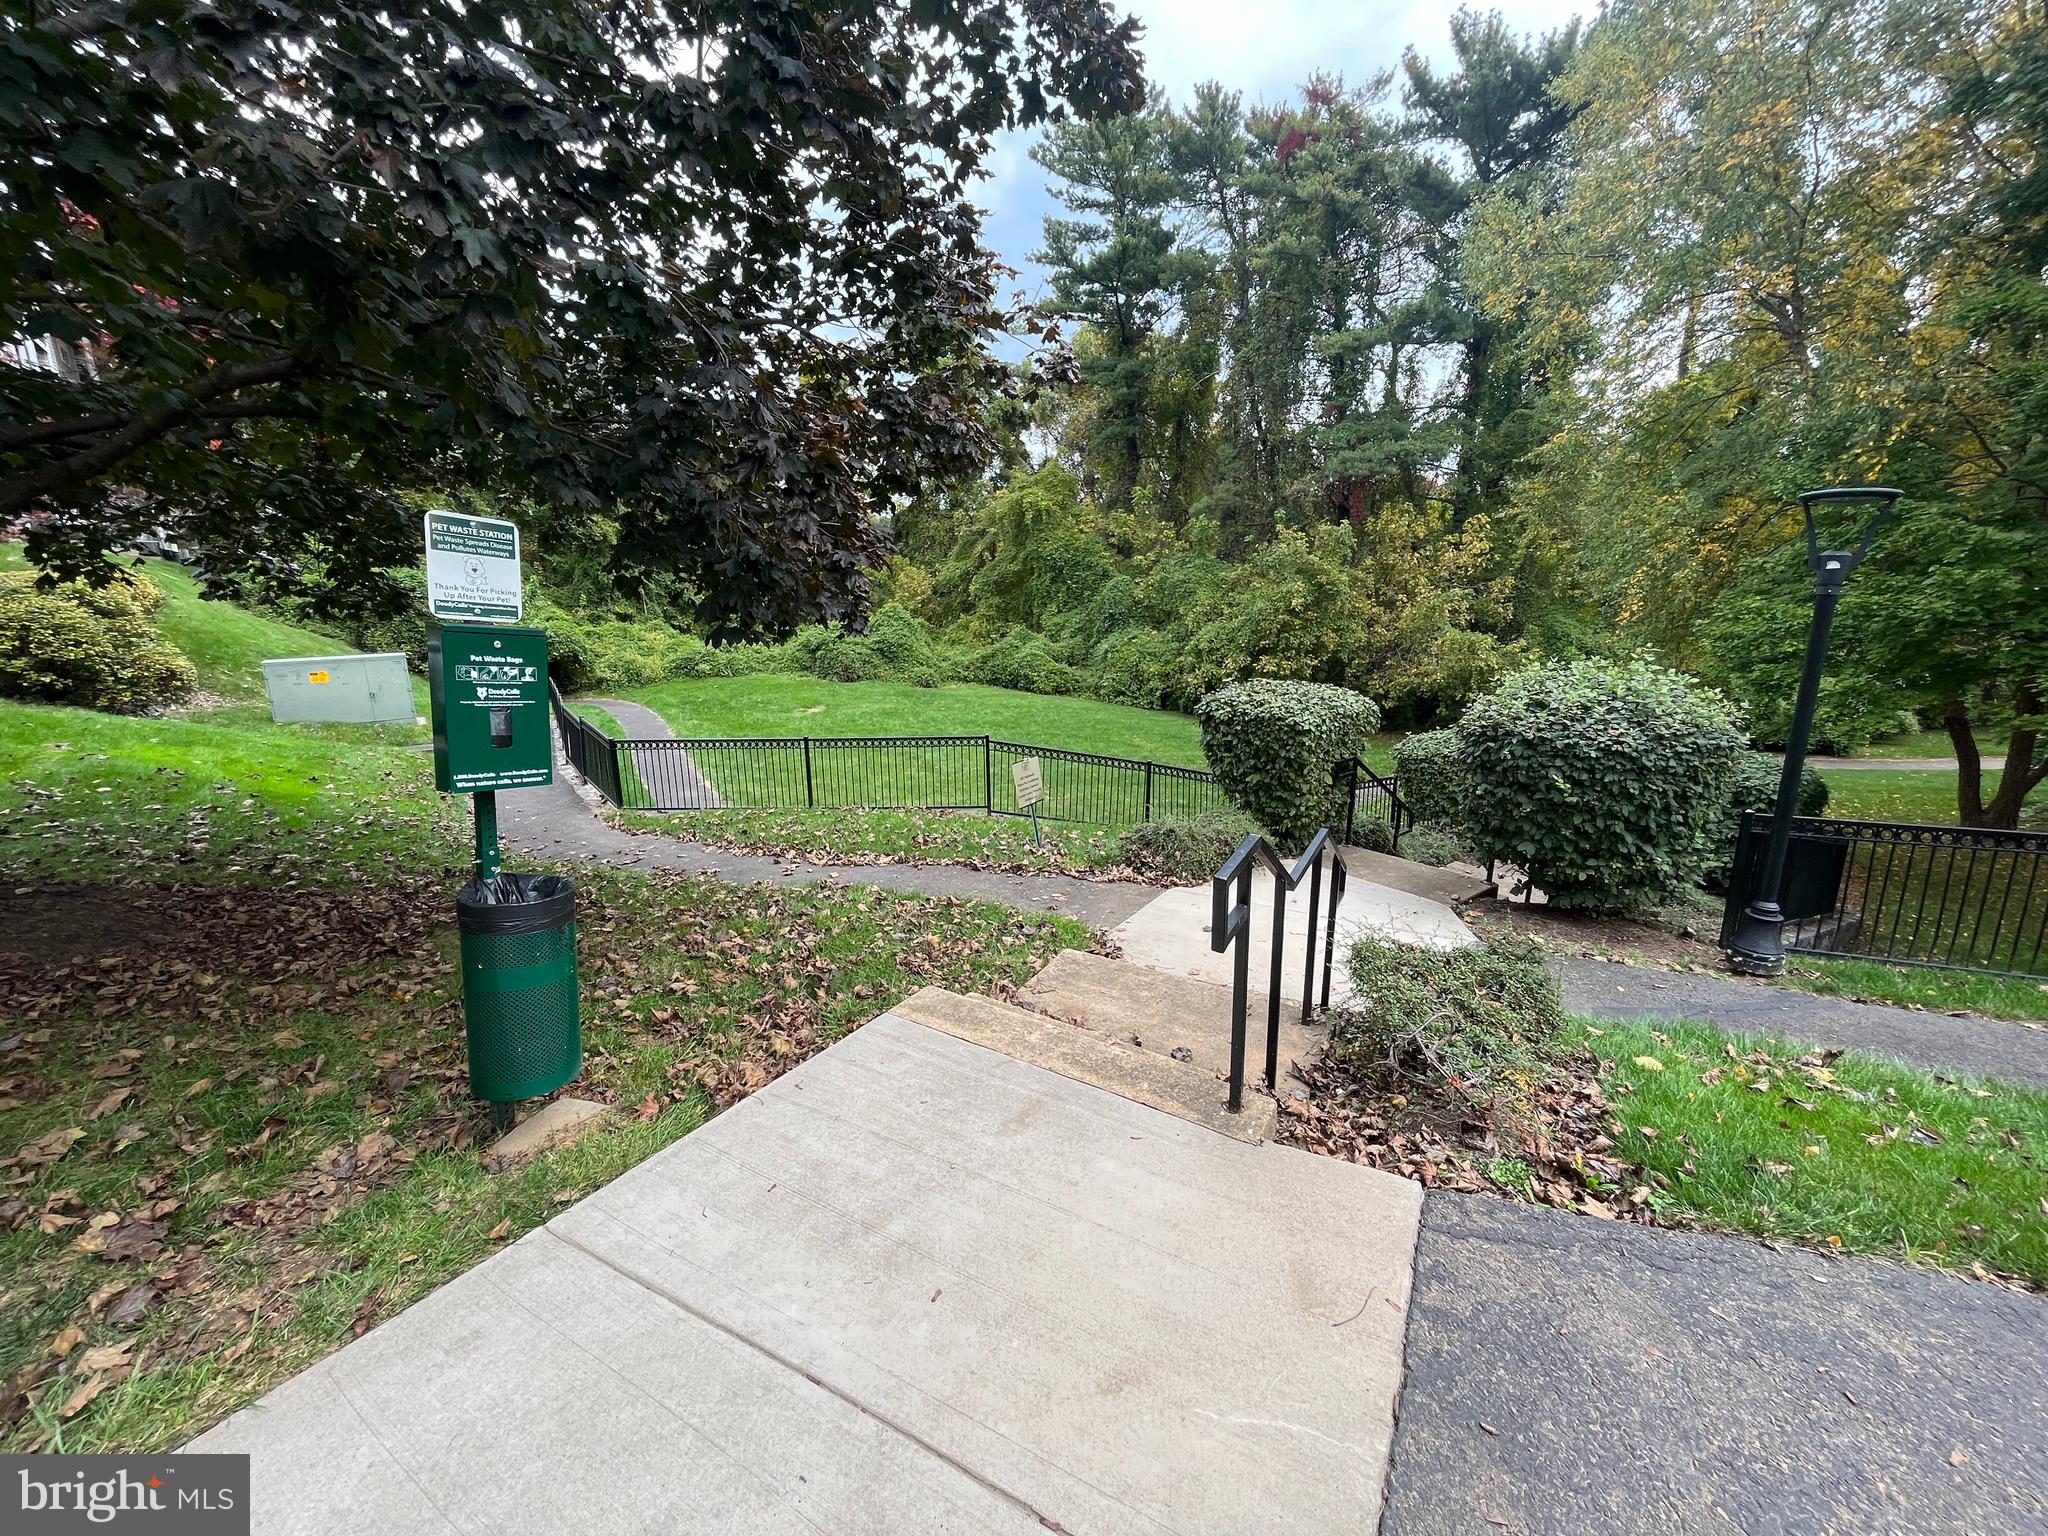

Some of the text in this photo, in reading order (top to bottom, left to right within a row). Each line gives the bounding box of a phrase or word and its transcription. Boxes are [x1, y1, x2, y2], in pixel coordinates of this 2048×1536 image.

[432, 523, 512, 540] PET WASTE STATION
[444, 536, 464, 544] Waste
[464, 538, 490, 548] Spreads
[490, 542, 513, 550] Disease
[451, 544, 476, 554] Pollutes
[477, 548, 510, 558] Waterways
[434, 582, 460, 591] Thank
[460, 584, 474, 593] You
[490, 588, 517, 597] Picking
[444, 592, 511, 604] Up After Your Pet!
